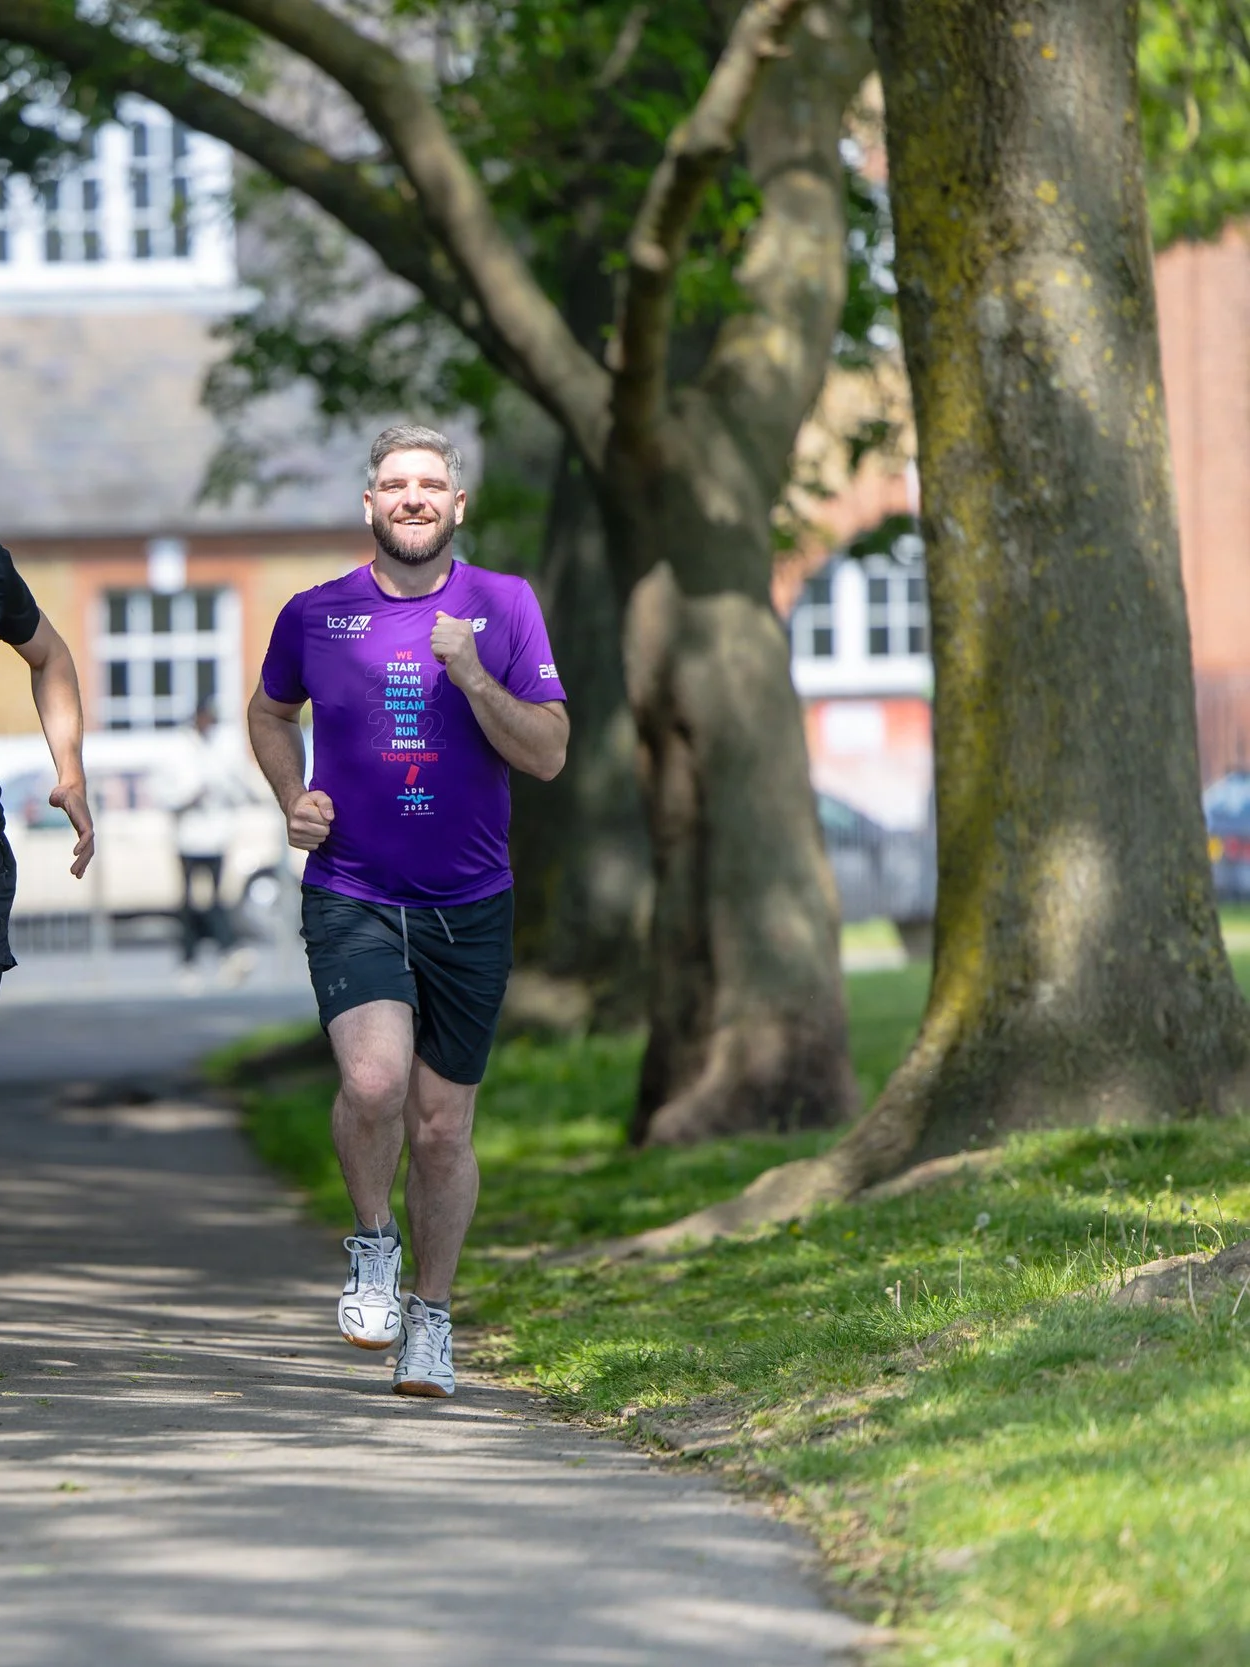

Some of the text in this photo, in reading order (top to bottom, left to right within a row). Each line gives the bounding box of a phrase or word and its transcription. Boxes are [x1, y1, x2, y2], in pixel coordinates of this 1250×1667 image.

[327, 614, 348, 629] tcs
[396, 650, 413, 660] WE
[386, 662, 421, 672] START
[387, 674, 421, 685] TRAIN
[385, 687, 423, 698] SWEAT
[385, 700, 425, 711] DREAM
[394, 713, 417, 724] WIN
[395, 726, 418, 737] RUN
[391, 739, 426, 750] FINISH
[381, 752, 439, 762] TOGETHER
[405, 787, 425, 795] LDN
[404, 803, 429, 811] 2022
